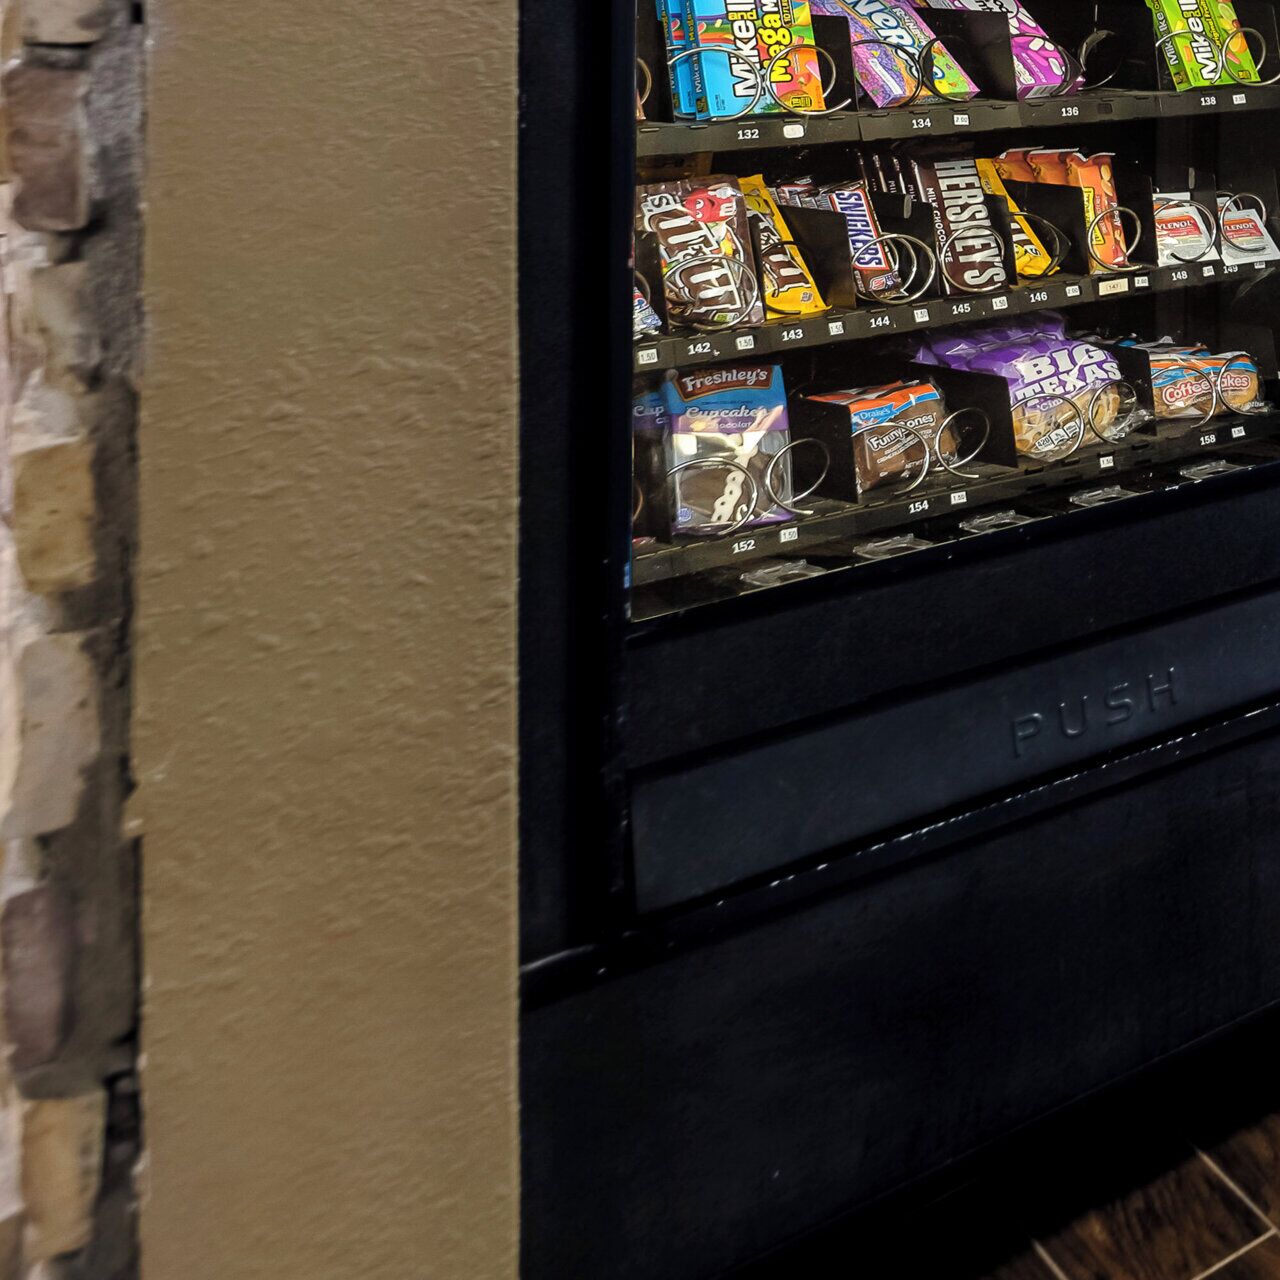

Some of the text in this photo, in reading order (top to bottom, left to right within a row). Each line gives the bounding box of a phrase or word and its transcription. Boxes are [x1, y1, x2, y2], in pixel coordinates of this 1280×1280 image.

[728, 11, 758, 21] and
[1182, 10, 1202, 18] and
[758, 13, 793, 83] Mega
[1187, 17, 1219, 81] Mike
[730, 20, 762, 98] Mike
[1200, 97, 1217, 106] 138
[1061, 106, 1079, 117] 136
[912, 118, 932, 129] 134
[737, 129, 760, 140] 132
[1109, 202, 1121, 227] Almod
[834, 190, 884, 268] SNICKERS
[926, 187, 954, 263] MILK CHOCOLTE
[933, 159, 1007, 287] HERSHEY'S
[1155, 220, 1193, 232] YLENOL
[1171, 270, 1189, 281] 148
[1222, 265, 1239, 275] 149
[1029, 292, 1048, 303] 146
[951, 303, 971, 315] 145
[869, 316, 891, 329] 144
[781, 329, 804, 342] 143
[688, 342, 712, 356] 142
[1018, 343, 1107, 384] BIG
[681, 368, 769, 393] Freshley's
[1014, 361, 1123, 406] TEXAS
[1163, 381, 1211, 404] Coffee
[685, 405, 769, 420] Cupcakes
[1200, 434, 1217, 446] 158
[908, 499, 930, 514] 154
[781, 530, 797, 541] 1.50
[732, 539, 756, 554] 152
[1009, 666, 1179, 759] PUSH
